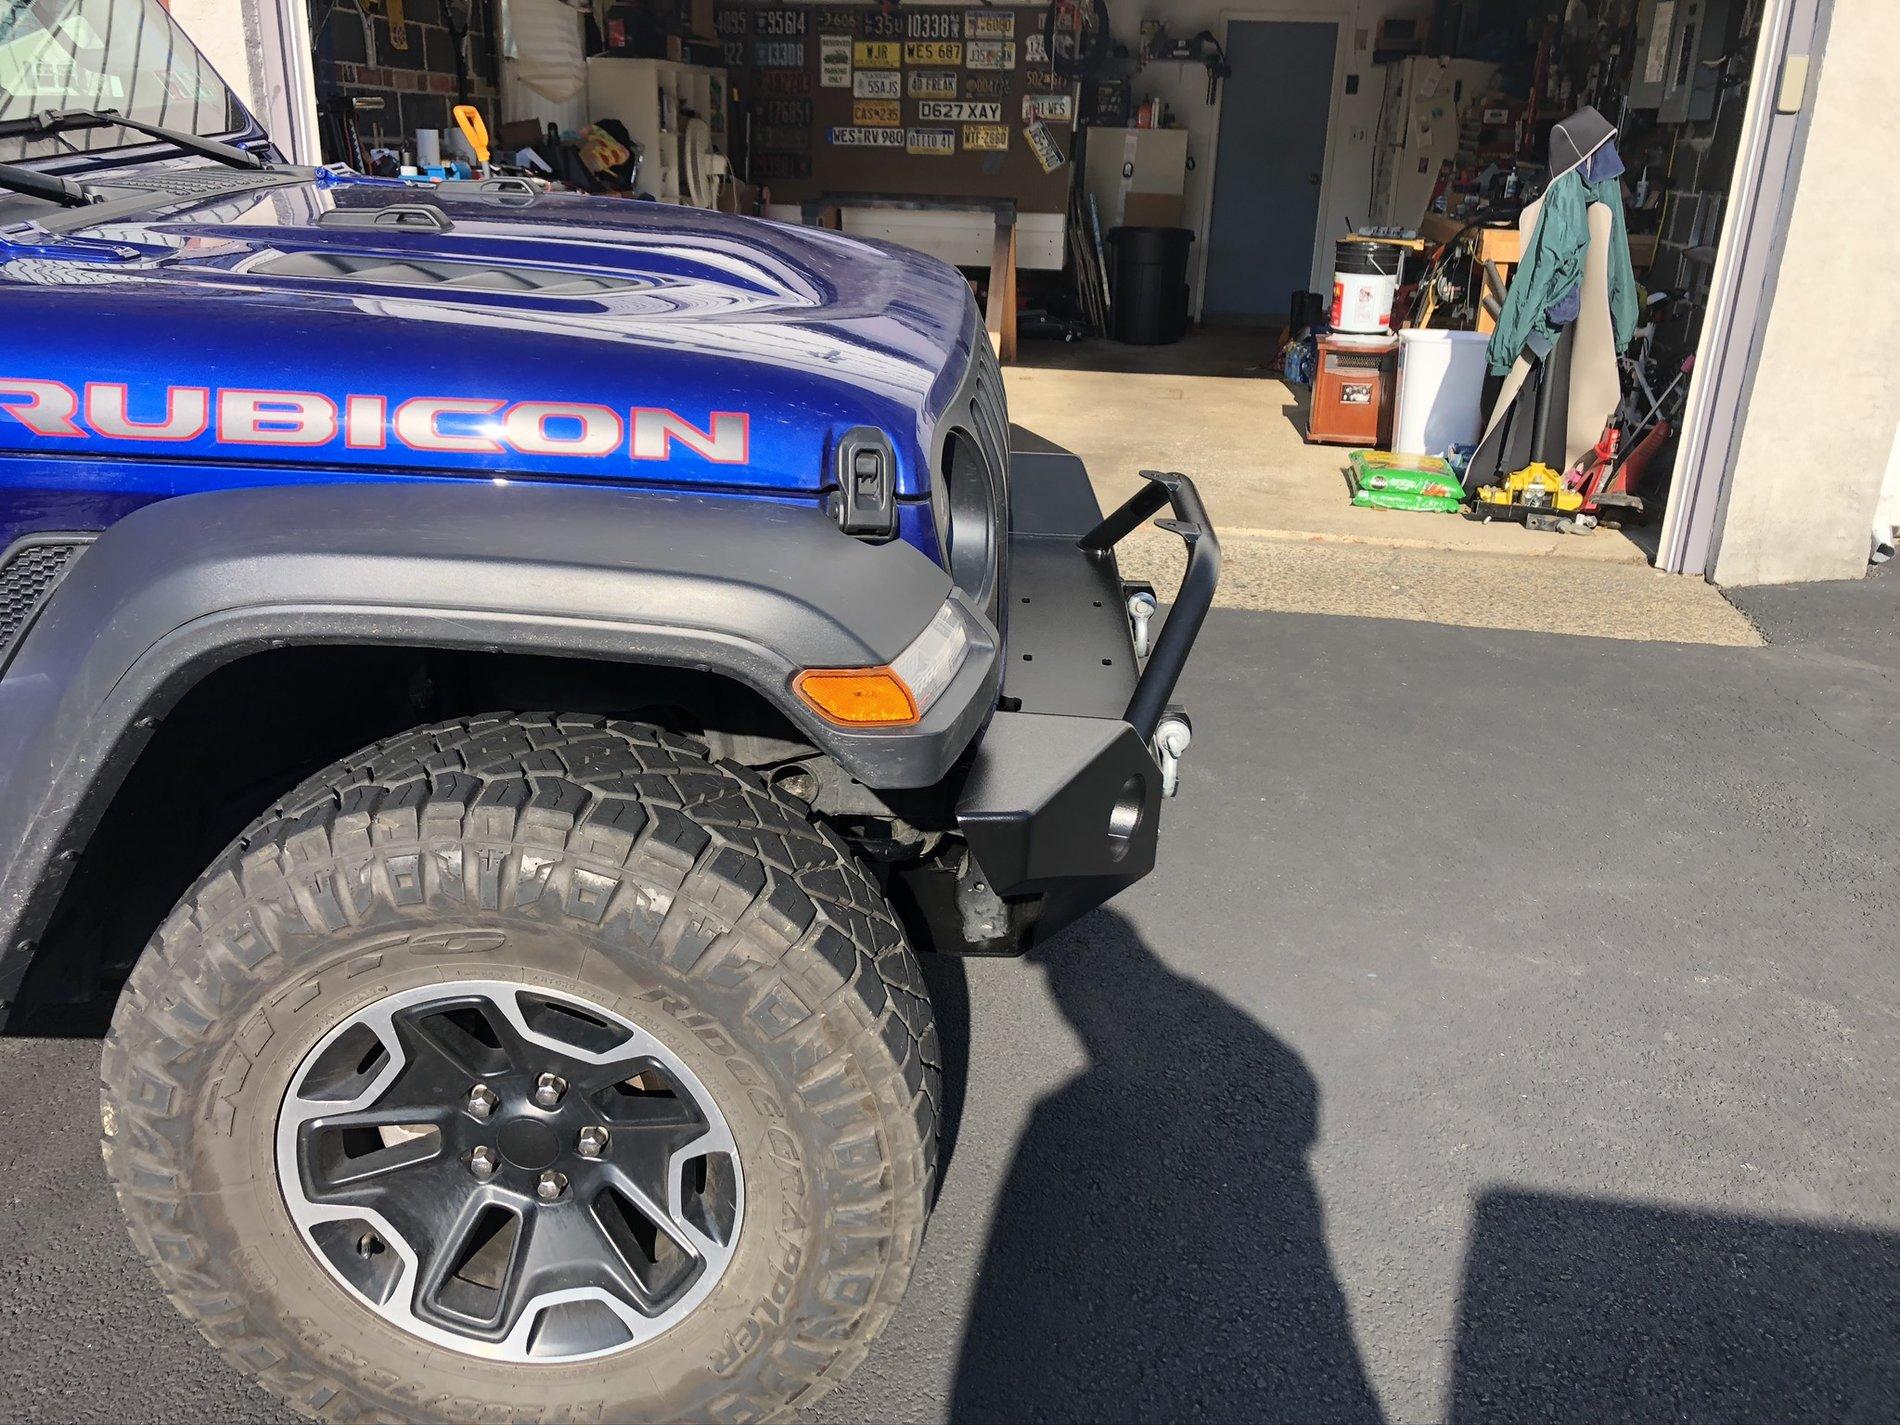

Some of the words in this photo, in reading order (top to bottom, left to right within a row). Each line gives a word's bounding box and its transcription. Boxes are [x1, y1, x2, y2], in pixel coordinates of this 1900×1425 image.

[907, 14, 949, 38] 10338
[907, 44, 933, 59] WES
[921, 103, 964, 119] D627
[968, 104, 1000, 119] XAY
[882, 130, 904, 145] 980
[0, 377, 750, 466] RUBICON
[634, 985, 785, 1120] RIDGE
[706, 1127, 807, 1378] GRAPPLER
